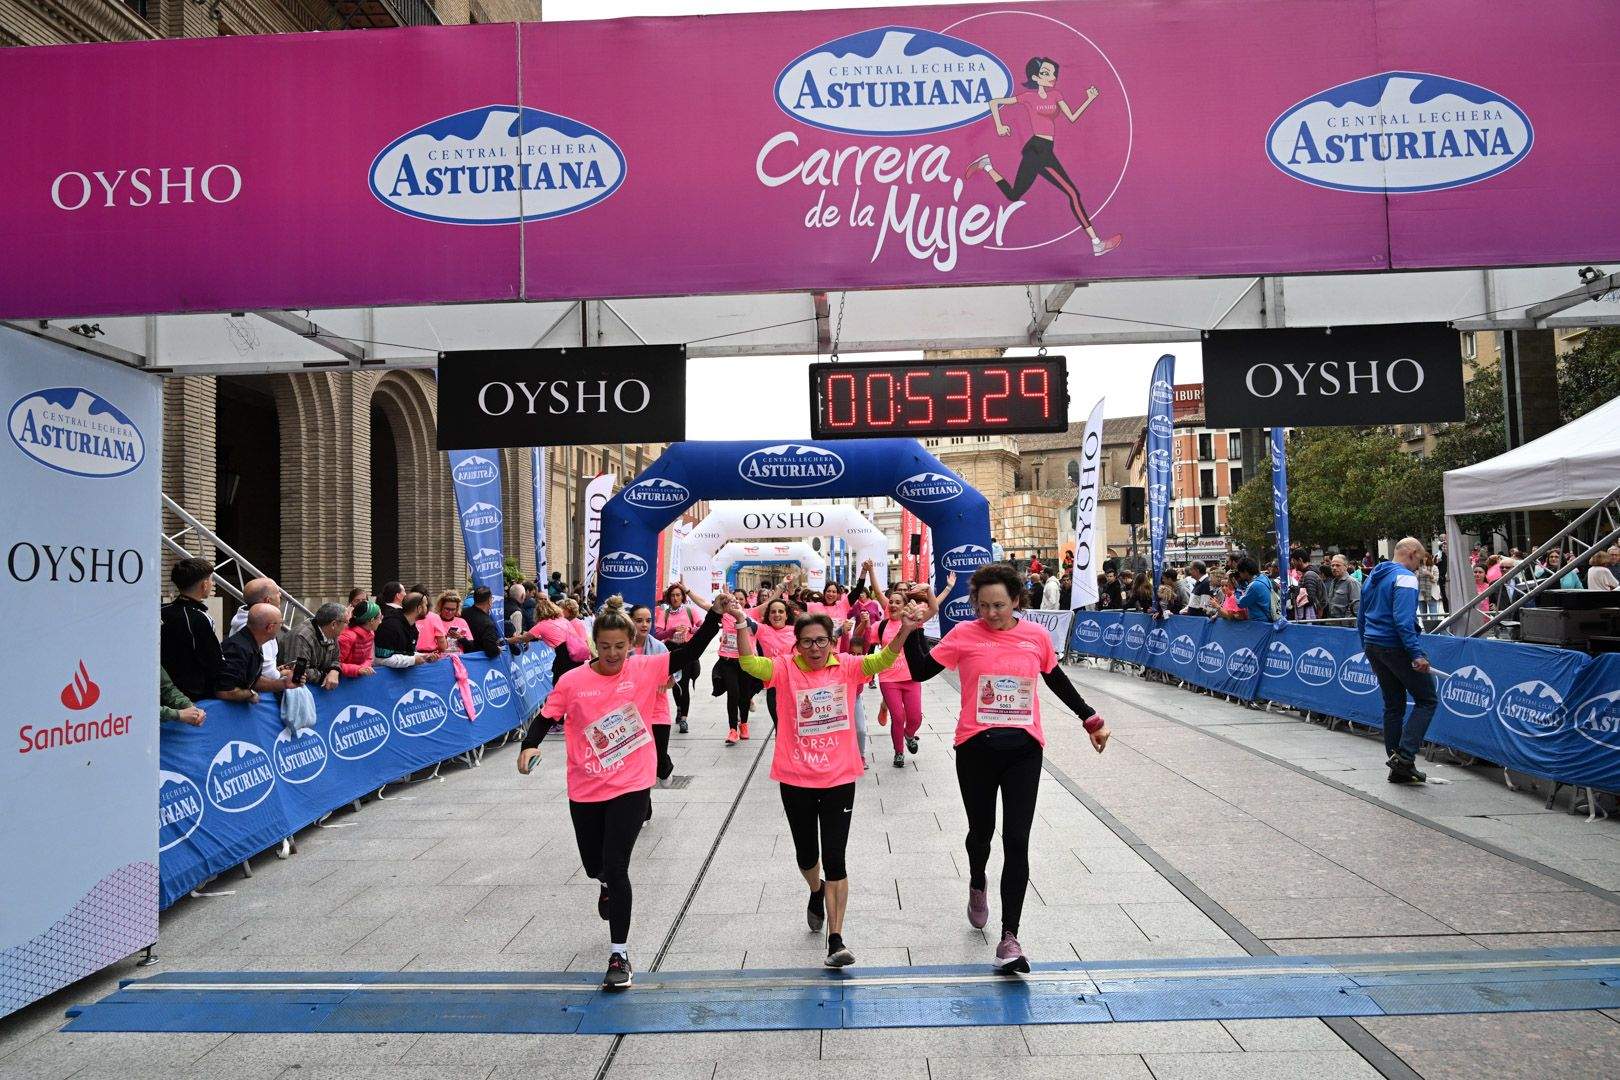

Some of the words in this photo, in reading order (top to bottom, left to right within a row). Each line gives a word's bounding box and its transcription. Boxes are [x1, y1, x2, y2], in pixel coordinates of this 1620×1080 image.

[829, 65, 903, 76] CENTRAL
[911, 62, 986, 73] LECHERA
[793, 70, 996, 110] ASTURIANA
[1327, 113, 1409, 128] CENTRAL
[1419, 110, 1503, 123] LECHERA
[428, 145, 507, 161] CENTRAL
[516, 142, 597, 157] LECHERA
[1288, 121, 1514, 164] ASTURIANA
[756, 131, 951, 187] Carrera
[51, 164, 242, 210] OYSHO
[388, 153, 607, 198] ASTURIANA
[805, 189, 840, 228] de
[849, 188, 875, 227] la
[871, 177, 1026, 272] Mujer
[1245, 358, 1424, 398] OYSHO
[478, 379, 651, 416] OYSHO
[19, 409, 137, 463] ASTURIANA
[42, 411, 89, 427] CENTRAL
[91, 422, 134, 438] LECHERA
[747, 459, 837, 478] ASTURIANA
[627, 489, 685, 501] ASTURIANA
[901, 485, 960, 496] ASTURIANA
[1077, 431, 1098, 570] OYSHO
[743, 512, 825, 529] OYSHO
[8, 542, 144, 584] OYSHO
[1266, 659, 1289, 670] TURIANA
[815, 705, 832, 713] 016
[996, 694, 1015, 702] 016
[398, 705, 445, 730] ASTURIANA
[19, 713, 133, 754] Santander
[335, 722, 387, 752] ASTURIANA
[608, 726, 626, 740] 016
[278, 744, 325, 774] ASTURIANA
[213, 763, 273, 803] ASTURIANA
